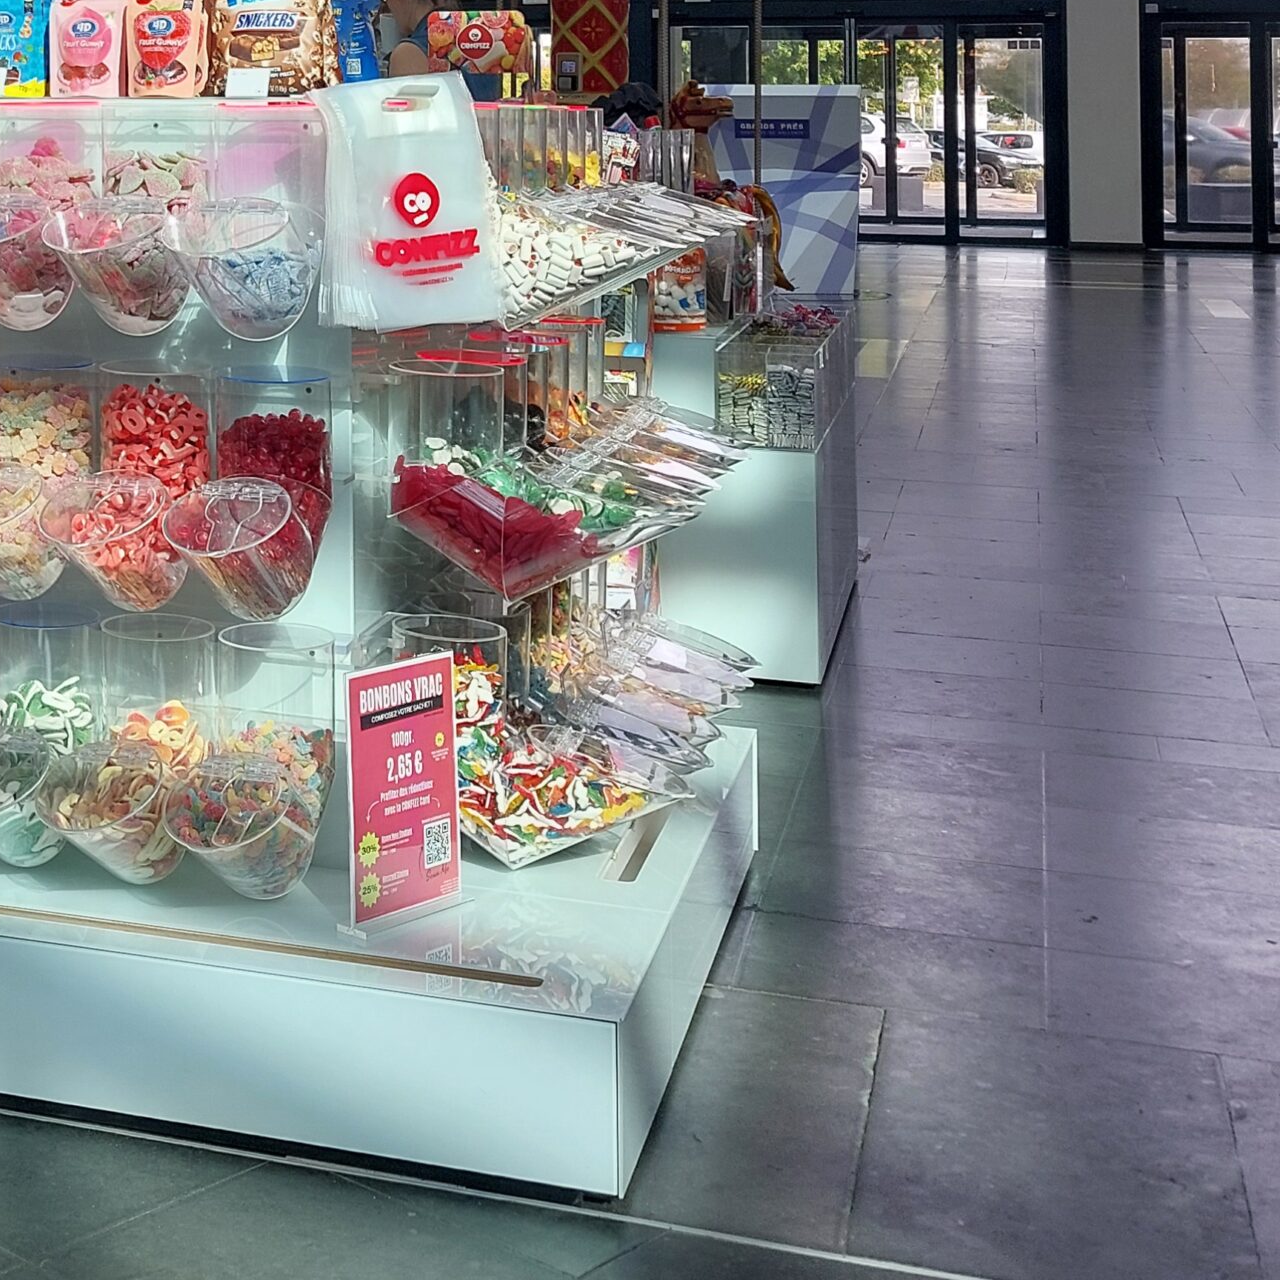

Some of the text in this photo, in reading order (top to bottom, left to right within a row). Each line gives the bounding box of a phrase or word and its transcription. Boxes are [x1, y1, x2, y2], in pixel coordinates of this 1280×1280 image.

[235, 12, 299, 30] SNICKERS
[376, 228, 481, 267] CONFIZZ
[360, 673, 443, 714] BONBONS VRAC
[371, 712, 397, 724] COMPOSEZ
[398, 707, 412, 717] VOTRE
[412, 701, 431, 712] SACHET
[387, 752, 413, 784] 2,65
[414, 750, 423, 775] €
[362, 844, 377, 856] 30%
[362, 883, 378, 896] 25%
